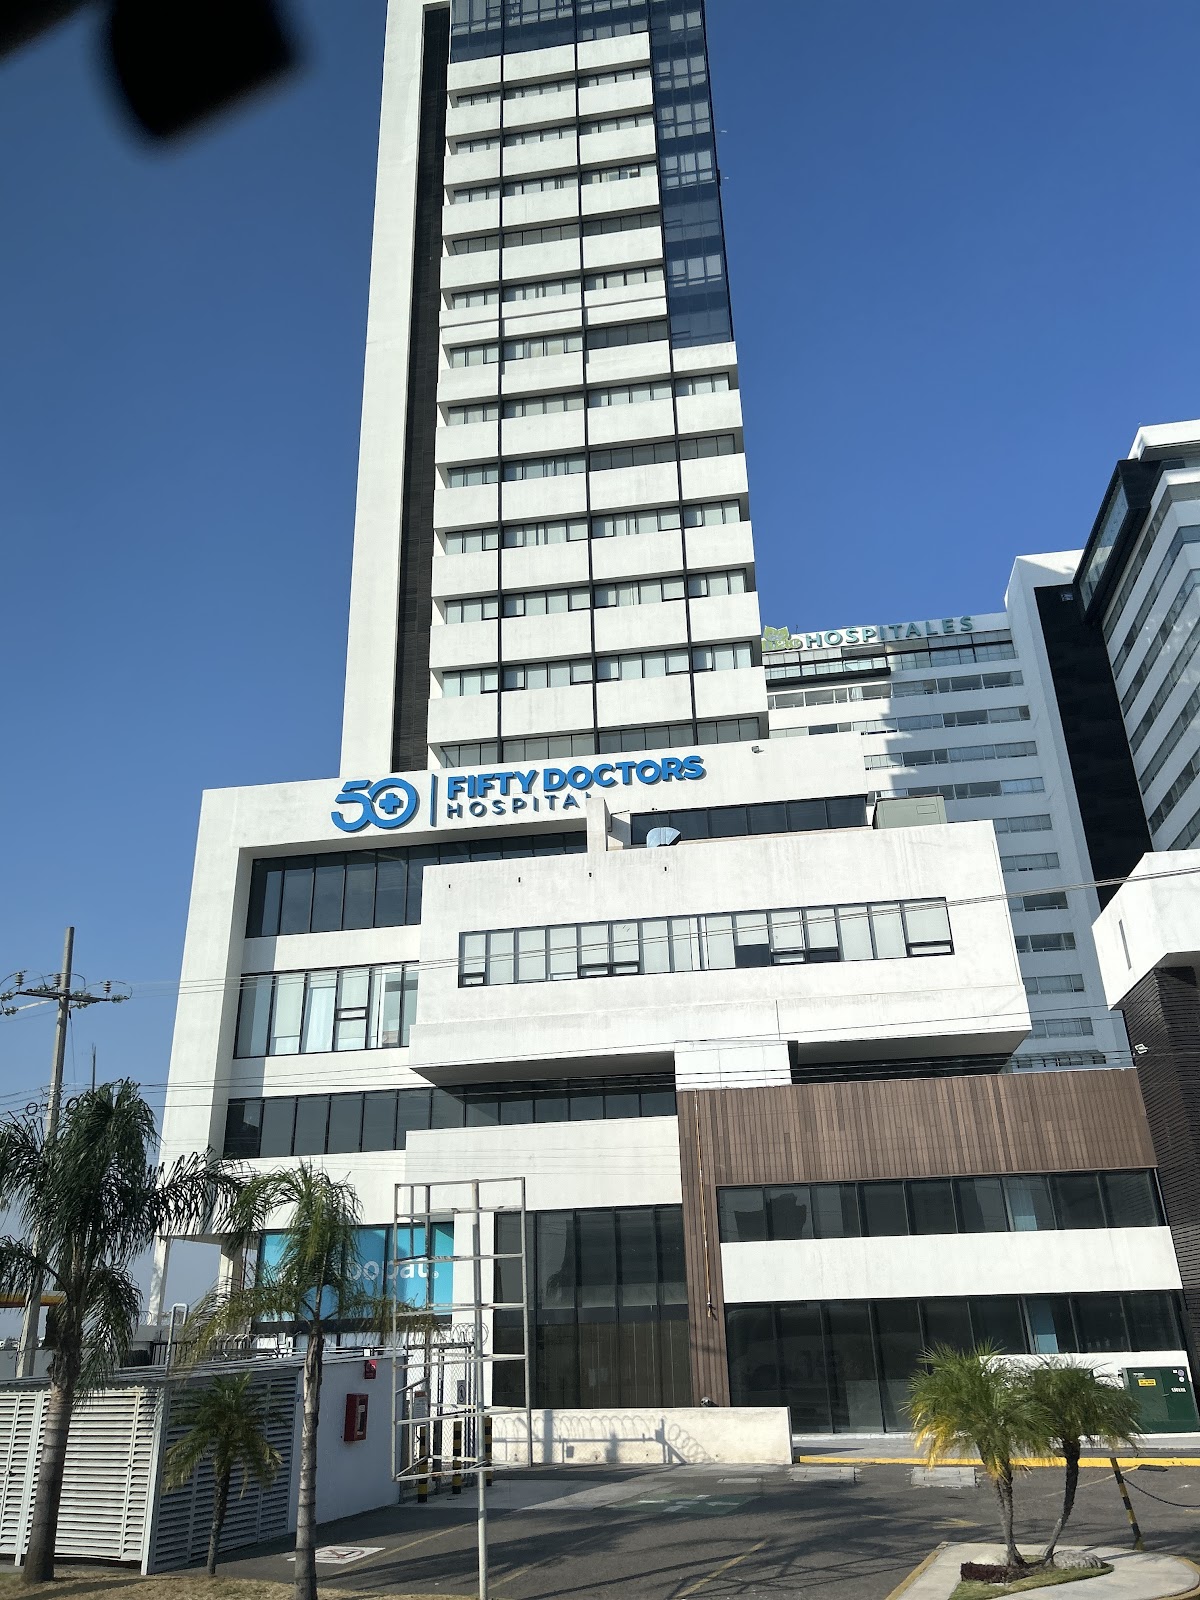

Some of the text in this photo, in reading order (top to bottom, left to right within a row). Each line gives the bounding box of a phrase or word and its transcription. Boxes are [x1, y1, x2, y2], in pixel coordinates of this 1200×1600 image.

[806, 616, 973, 648] HOSPITALES
[448, 755, 705, 800] FIFTY DOCTORS
[331, 778, 419, 832] 50
[447, 791, 592, 819] HOSPITA
